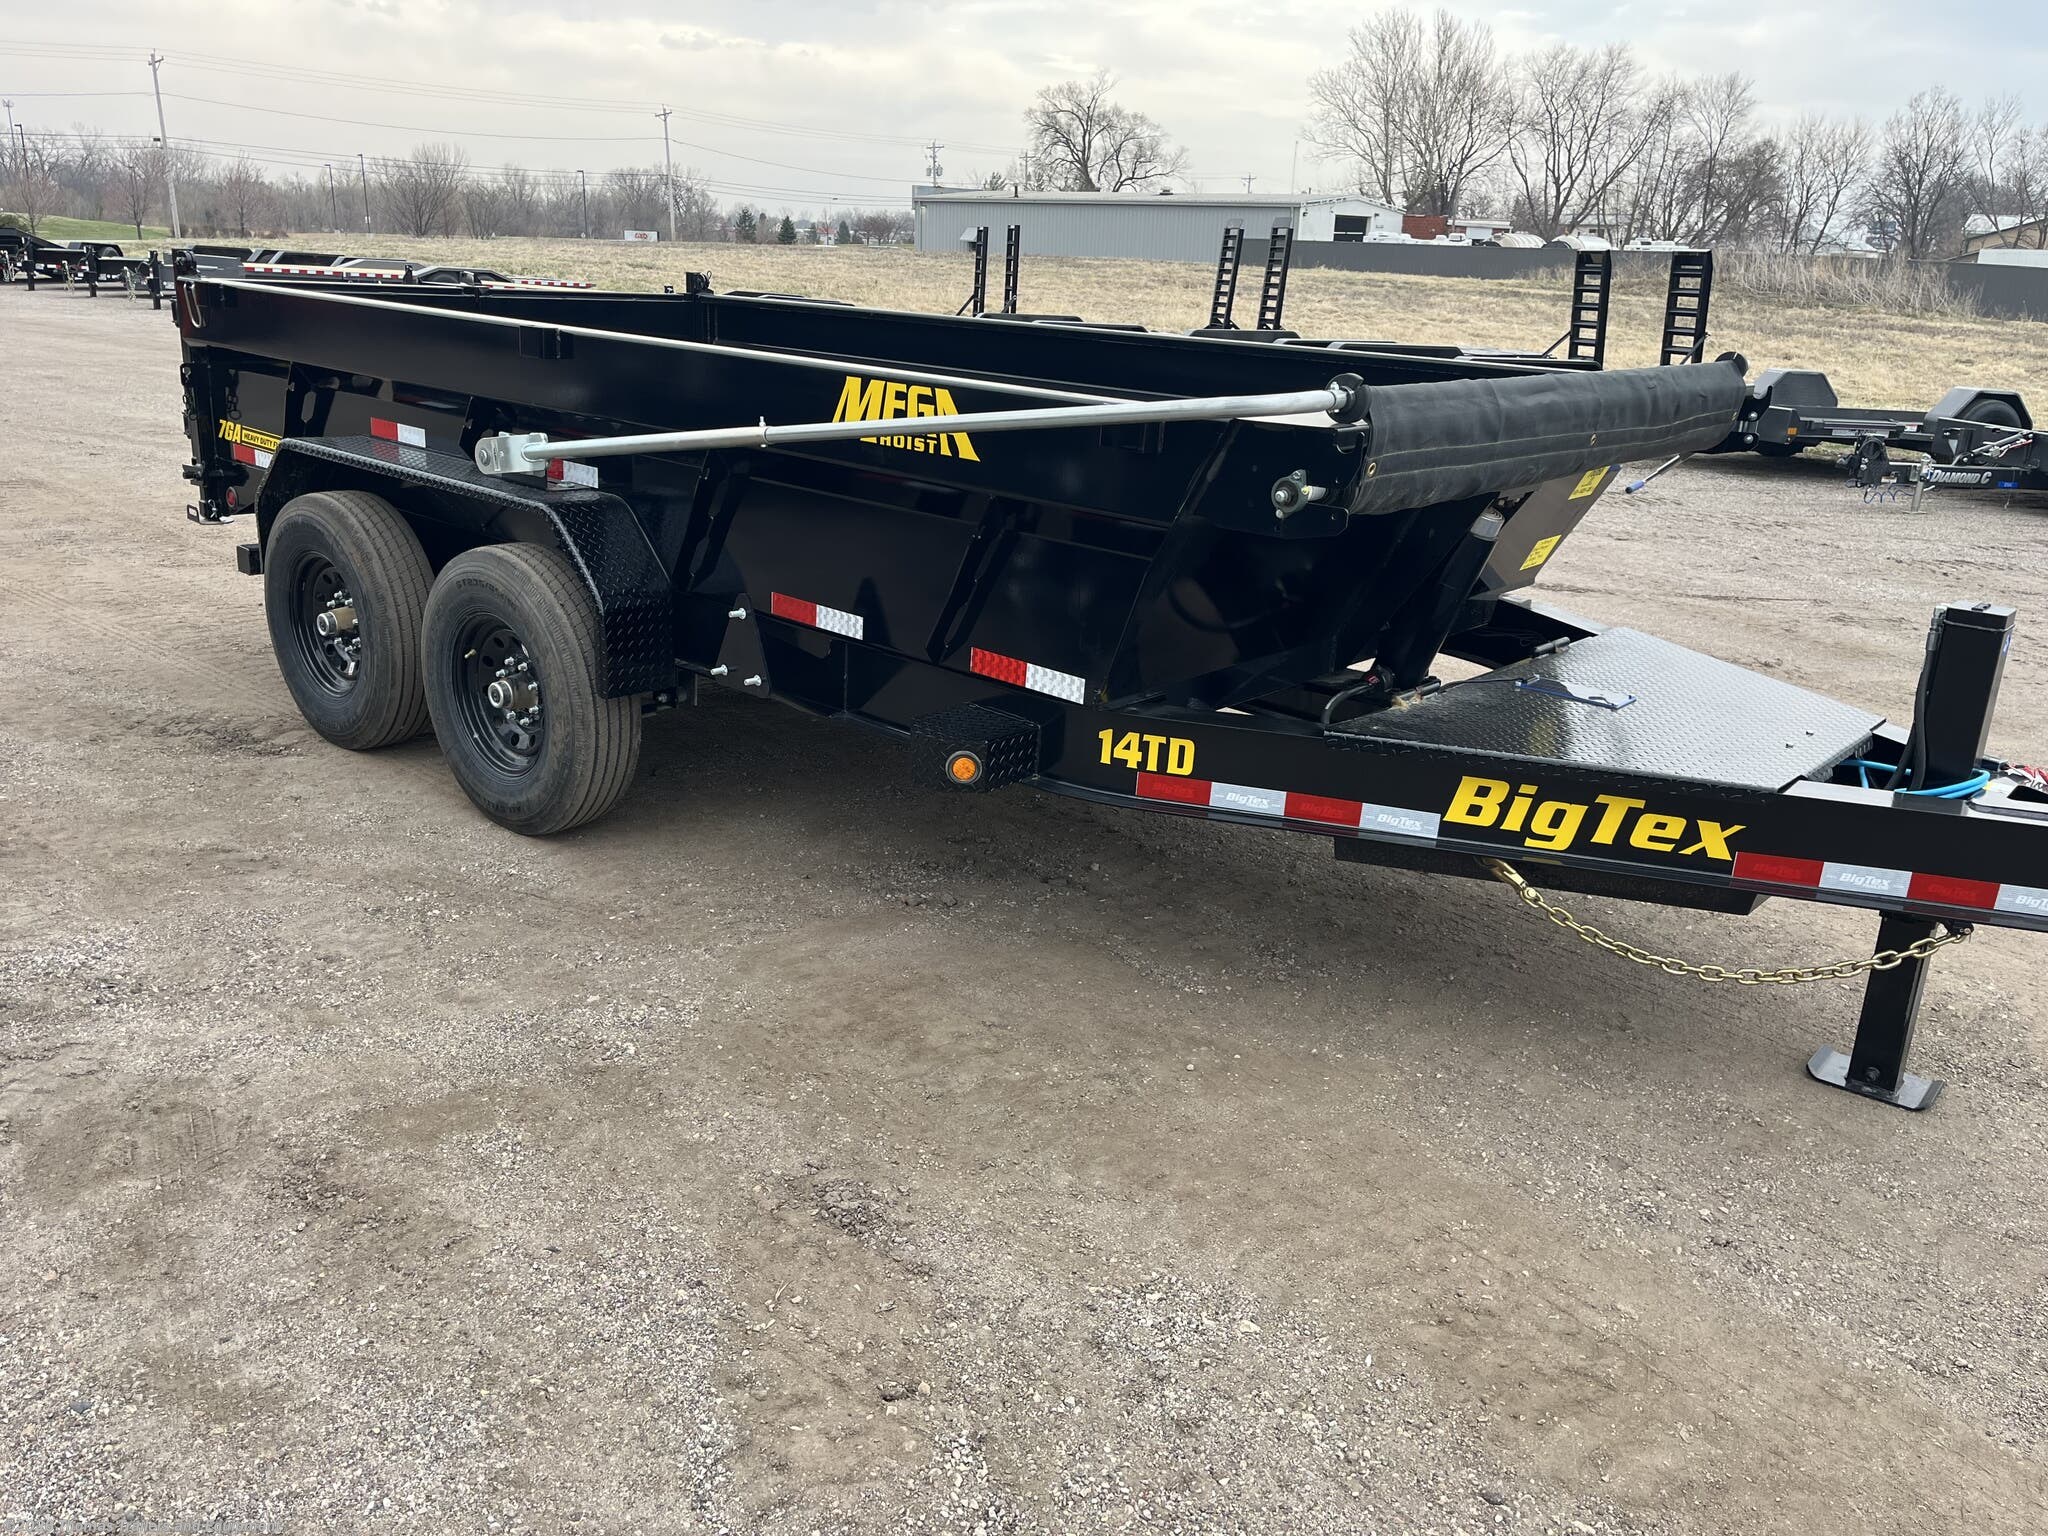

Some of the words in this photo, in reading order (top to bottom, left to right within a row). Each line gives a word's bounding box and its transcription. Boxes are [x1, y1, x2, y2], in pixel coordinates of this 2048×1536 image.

[832, 376, 981, 462] MEGA
[218, 419, 242, 443] 7GA
[243, 431, 260, 444] HEAVY
[260, 437, 273, 447] DUTY
[880, 435, 938, 454] HOIST
[1930, 469, 1981, 484] DIAMOND
[1981, 471, 1993, 484] C
[1098, 728, 1196, 776] 14TD
[1226, 792, 1270, 806] BigTex
[1377, 814, 1424, 828] BigTex
[1443, 776, 1747, 861] BigTex
[1840, 872, 1891, 887] BigTex
[2015, 895, 2048, 911] BigT
